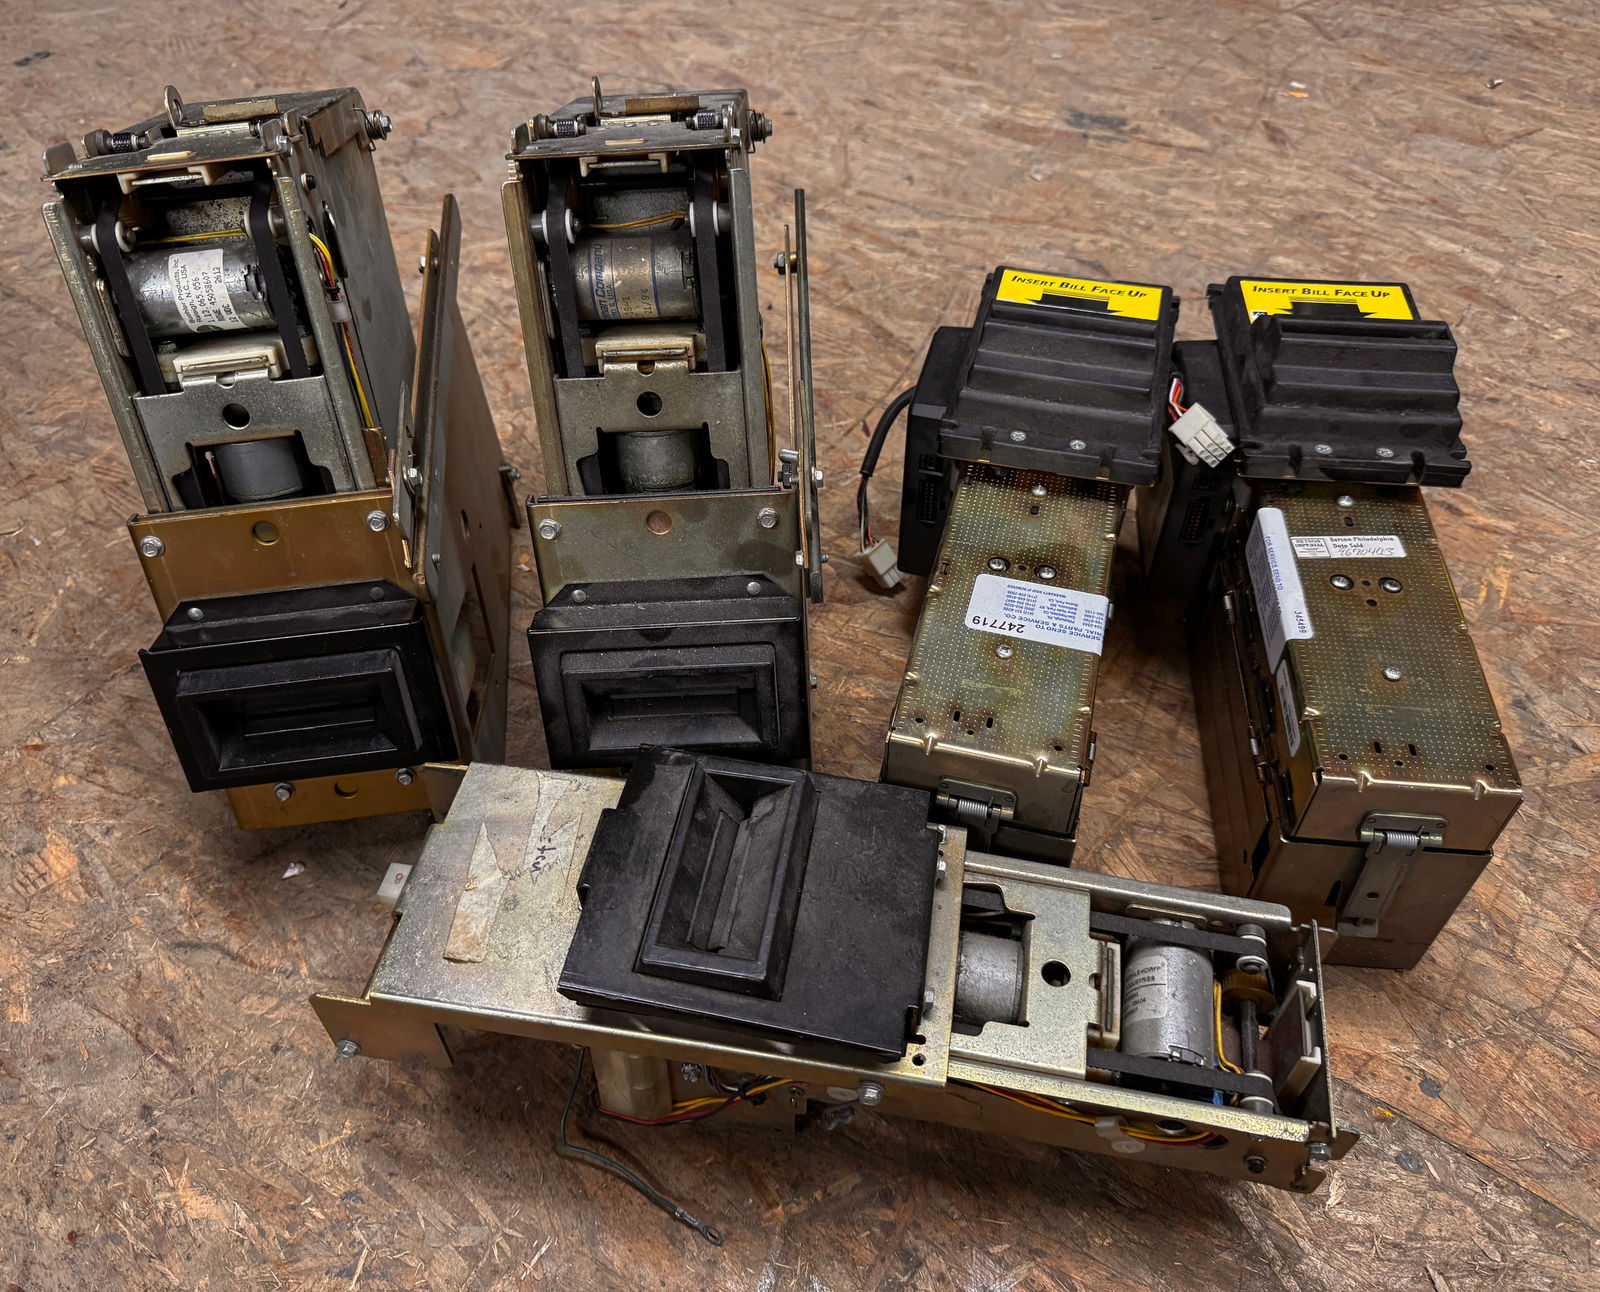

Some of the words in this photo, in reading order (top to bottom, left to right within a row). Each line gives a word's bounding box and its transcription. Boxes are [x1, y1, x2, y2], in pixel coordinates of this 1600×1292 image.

[180, 264, 188, 279] USA
[212, 266, 222, 285] 2612
[594, 244, 606, 298] Company
[606, 284, 615, 300] USA
[1264, 536, 1273, 547] FOR
[1268, 547, 1278, 569] SERVICE
[1273, 569, 1281, 583] SEND
[1276, 583, 1284, 591] TO
[972, 615, 1026, 634] 247719
[1018, 616, 1050, 626] SERVICE
[1046, 627, 1067, 635] SEND
[1059, 624, 1083, 633] PARTS
[1069, 631, 1101, 641] SERVICE
